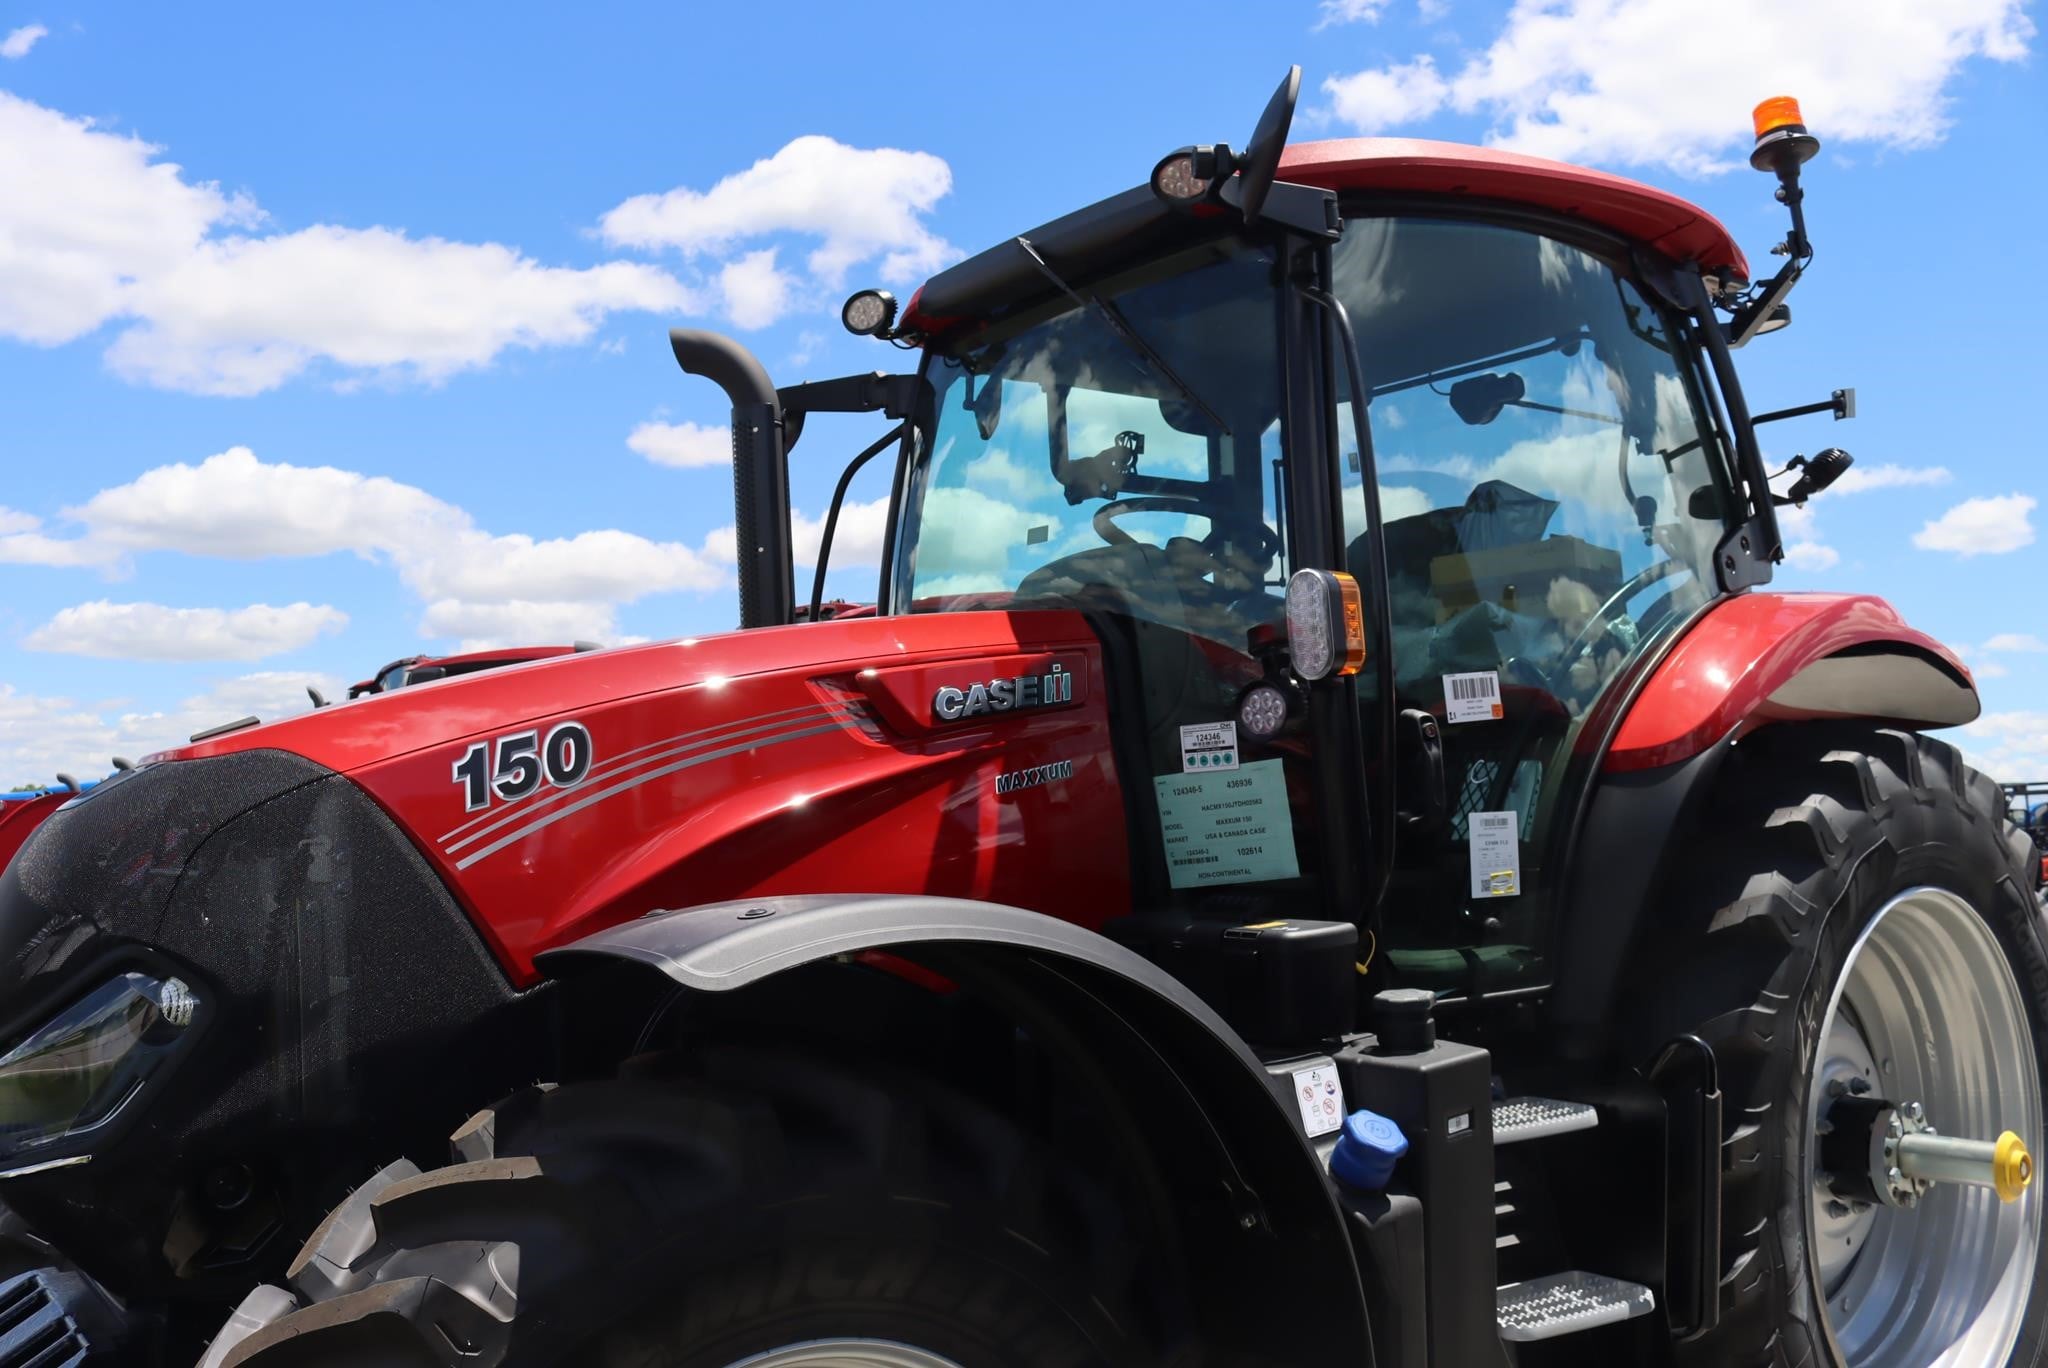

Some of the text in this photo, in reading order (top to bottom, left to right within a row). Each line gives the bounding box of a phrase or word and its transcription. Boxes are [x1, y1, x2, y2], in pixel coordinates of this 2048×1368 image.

[935, 678, 1038, 720] CASE
[1196, 732, 1221, 742] 124346
[451, 719, 594, 814] 150
[995, 760, 1073, 795] MAXXUM
[1226, 778, 1253, 789] 436936
[1164, 823, 1184, 831] MODEL
[1166, 835, 1189, 844] MARKET
[1205, 832, 1217, 840] USA
[1224, 829, 1248, 837] CANADA
[1249, 827, 1267, 835] CASE
[1237, 846, 1263, 856] 102614
